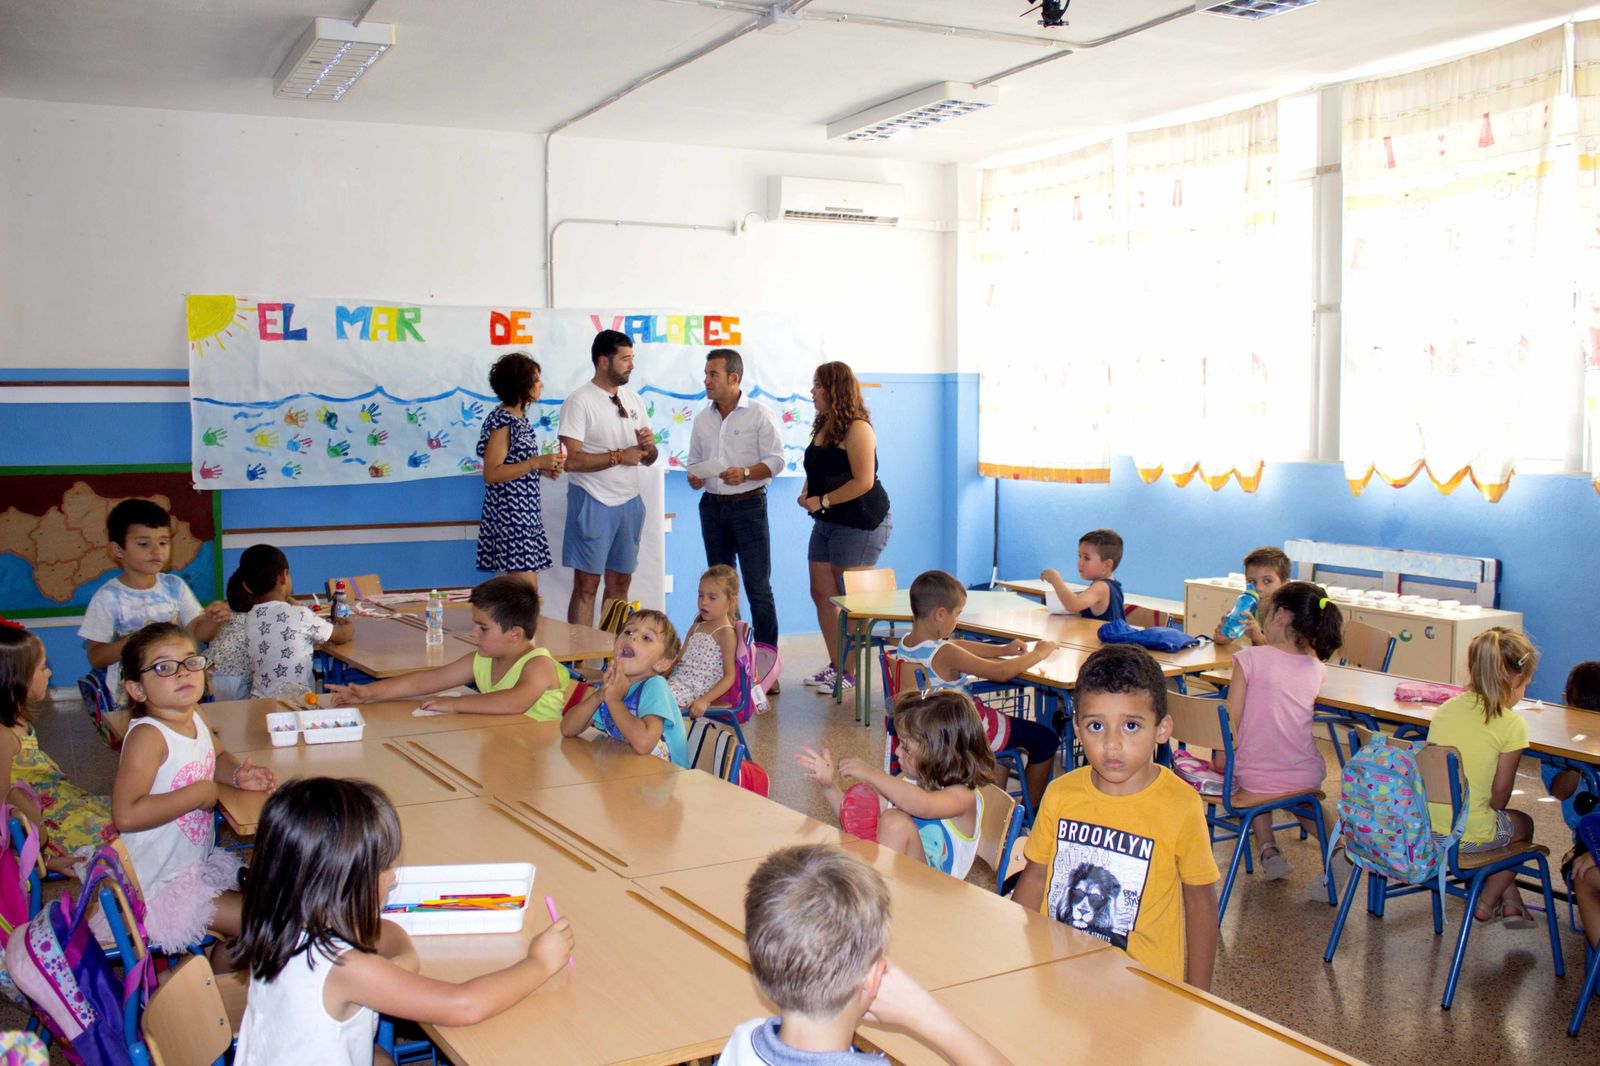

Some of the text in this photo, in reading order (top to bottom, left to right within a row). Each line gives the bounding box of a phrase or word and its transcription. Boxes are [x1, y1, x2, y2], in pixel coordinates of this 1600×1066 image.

[257, 303, 742, 346] EL MAR DE VALORES
[1058, 820, 1153, 859] BROOKLYN
